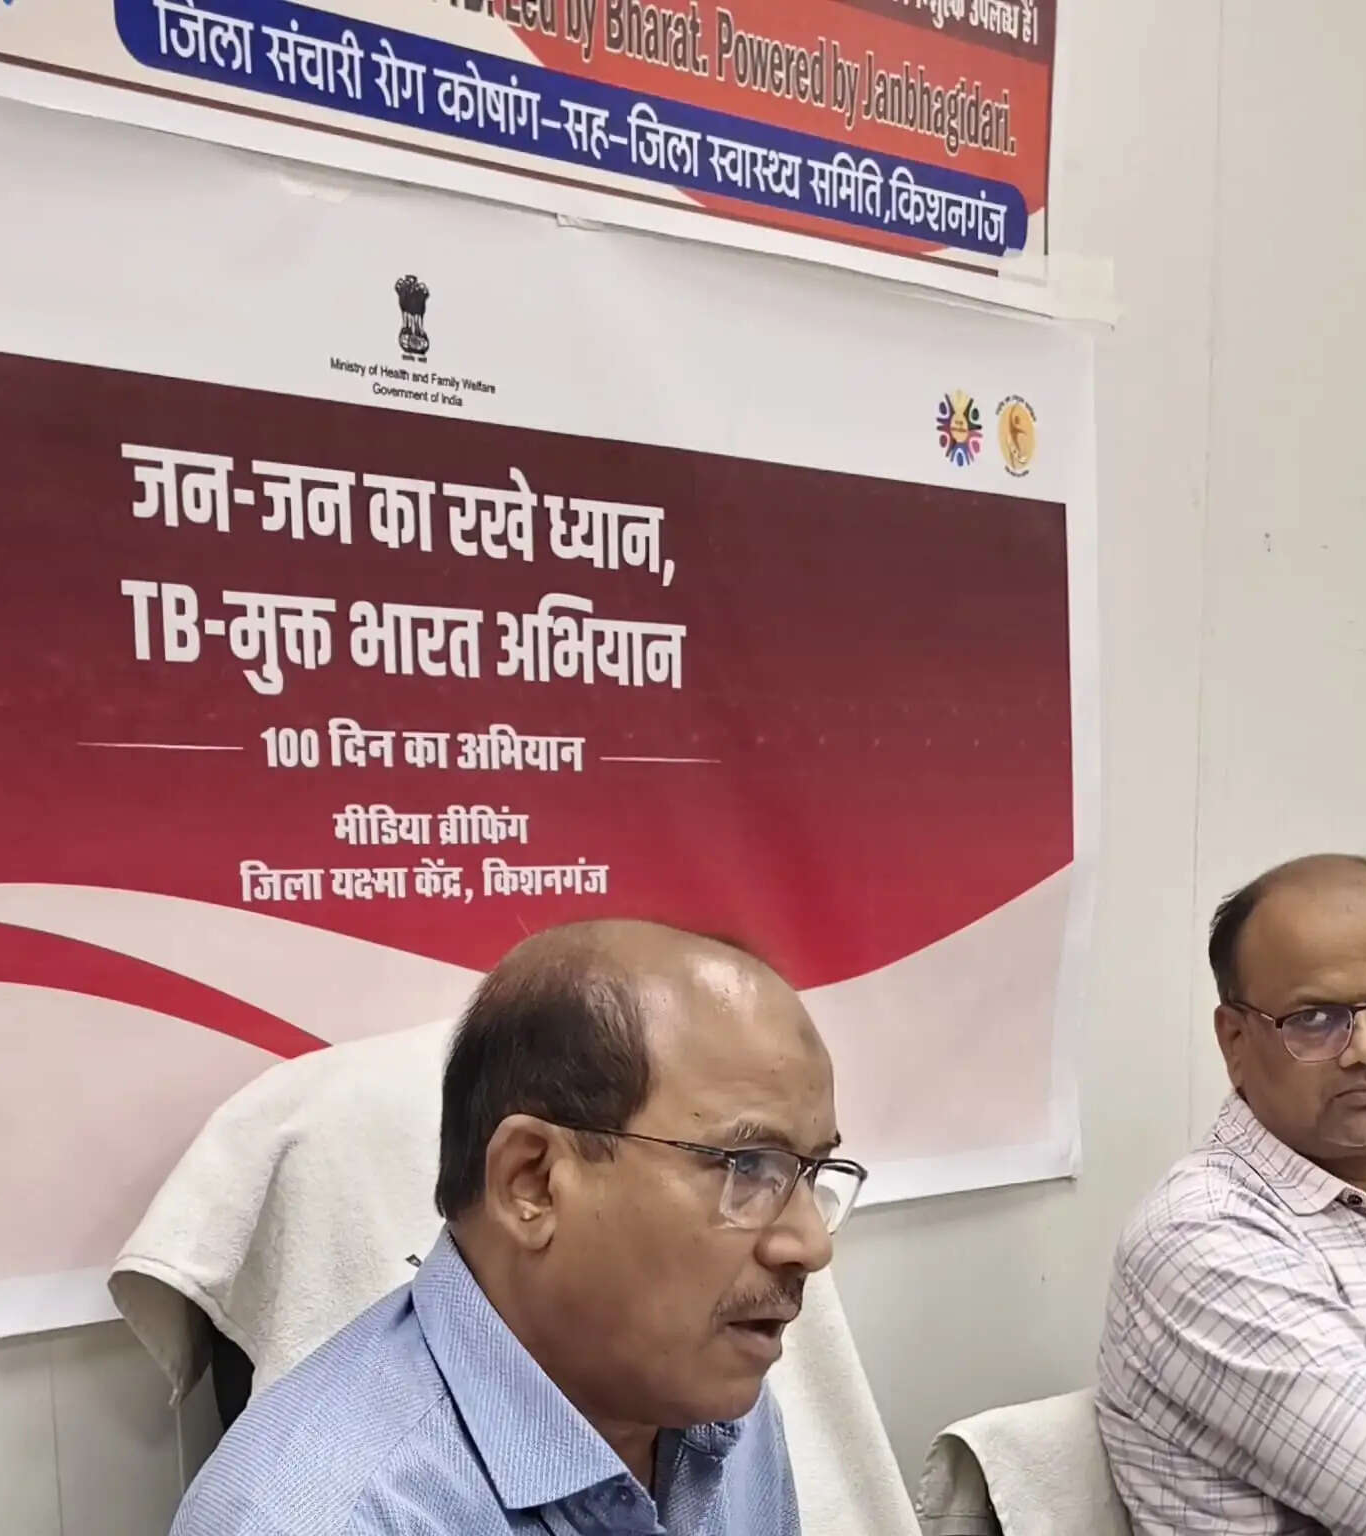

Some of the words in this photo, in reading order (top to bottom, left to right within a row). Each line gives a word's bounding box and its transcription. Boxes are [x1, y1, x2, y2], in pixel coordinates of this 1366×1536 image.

[155, 0, 252, 75] जिला
[267, 18, 363, 102] संचारी
[373, 38, 426, 114] रोग
[707, 134, 801, 201] स्वास्थ्य
[604, 0, 709, 77] Bharat.
[716, 6, 829, 109] Powered
[832, 40, 860, 131] by
[863, 50, 1017, 157] Janbhagidari.
[330, 357, 366, 376] Ministry
[368, 363, 378, 376] of
[380, 366, 410, 381] Health
[412, 370, 429, 383] and
[431, 373, 460, 391] Family
[462, 378, 496, 394] Welfare
[373, 382, 428, 402] Government
[430, 390, 439, 403] of
[441, 392, 463, 407] India
[121, 443, 355, 545] जन-जन
[363, 472, 435, 552] का
[443, 467, 536, 562] रखे
[545, 494, 675, 587] ध्यान,
[121, 579, 337, 695] TB-मुक्त
[350, 600, 483, 679] भारत
[497, 592, 687, 689] अभियान
[260, 726, 319, 769] 100
[327, 718, 394, 769] दिन
[403, 730, 449, 770] का
[457, 723, 586, 773] अभियान
[333, 804, 433, 845] मीडिया
[438, 805, 530, 846] ब्रीफिंग
[240, 860, 323, 902] जिला
[331, 864, 407, 901] यक्ष्मा
[414, 858, 474, 905] केंद्र,
[483, 857, 610, 898] किशनगंज
